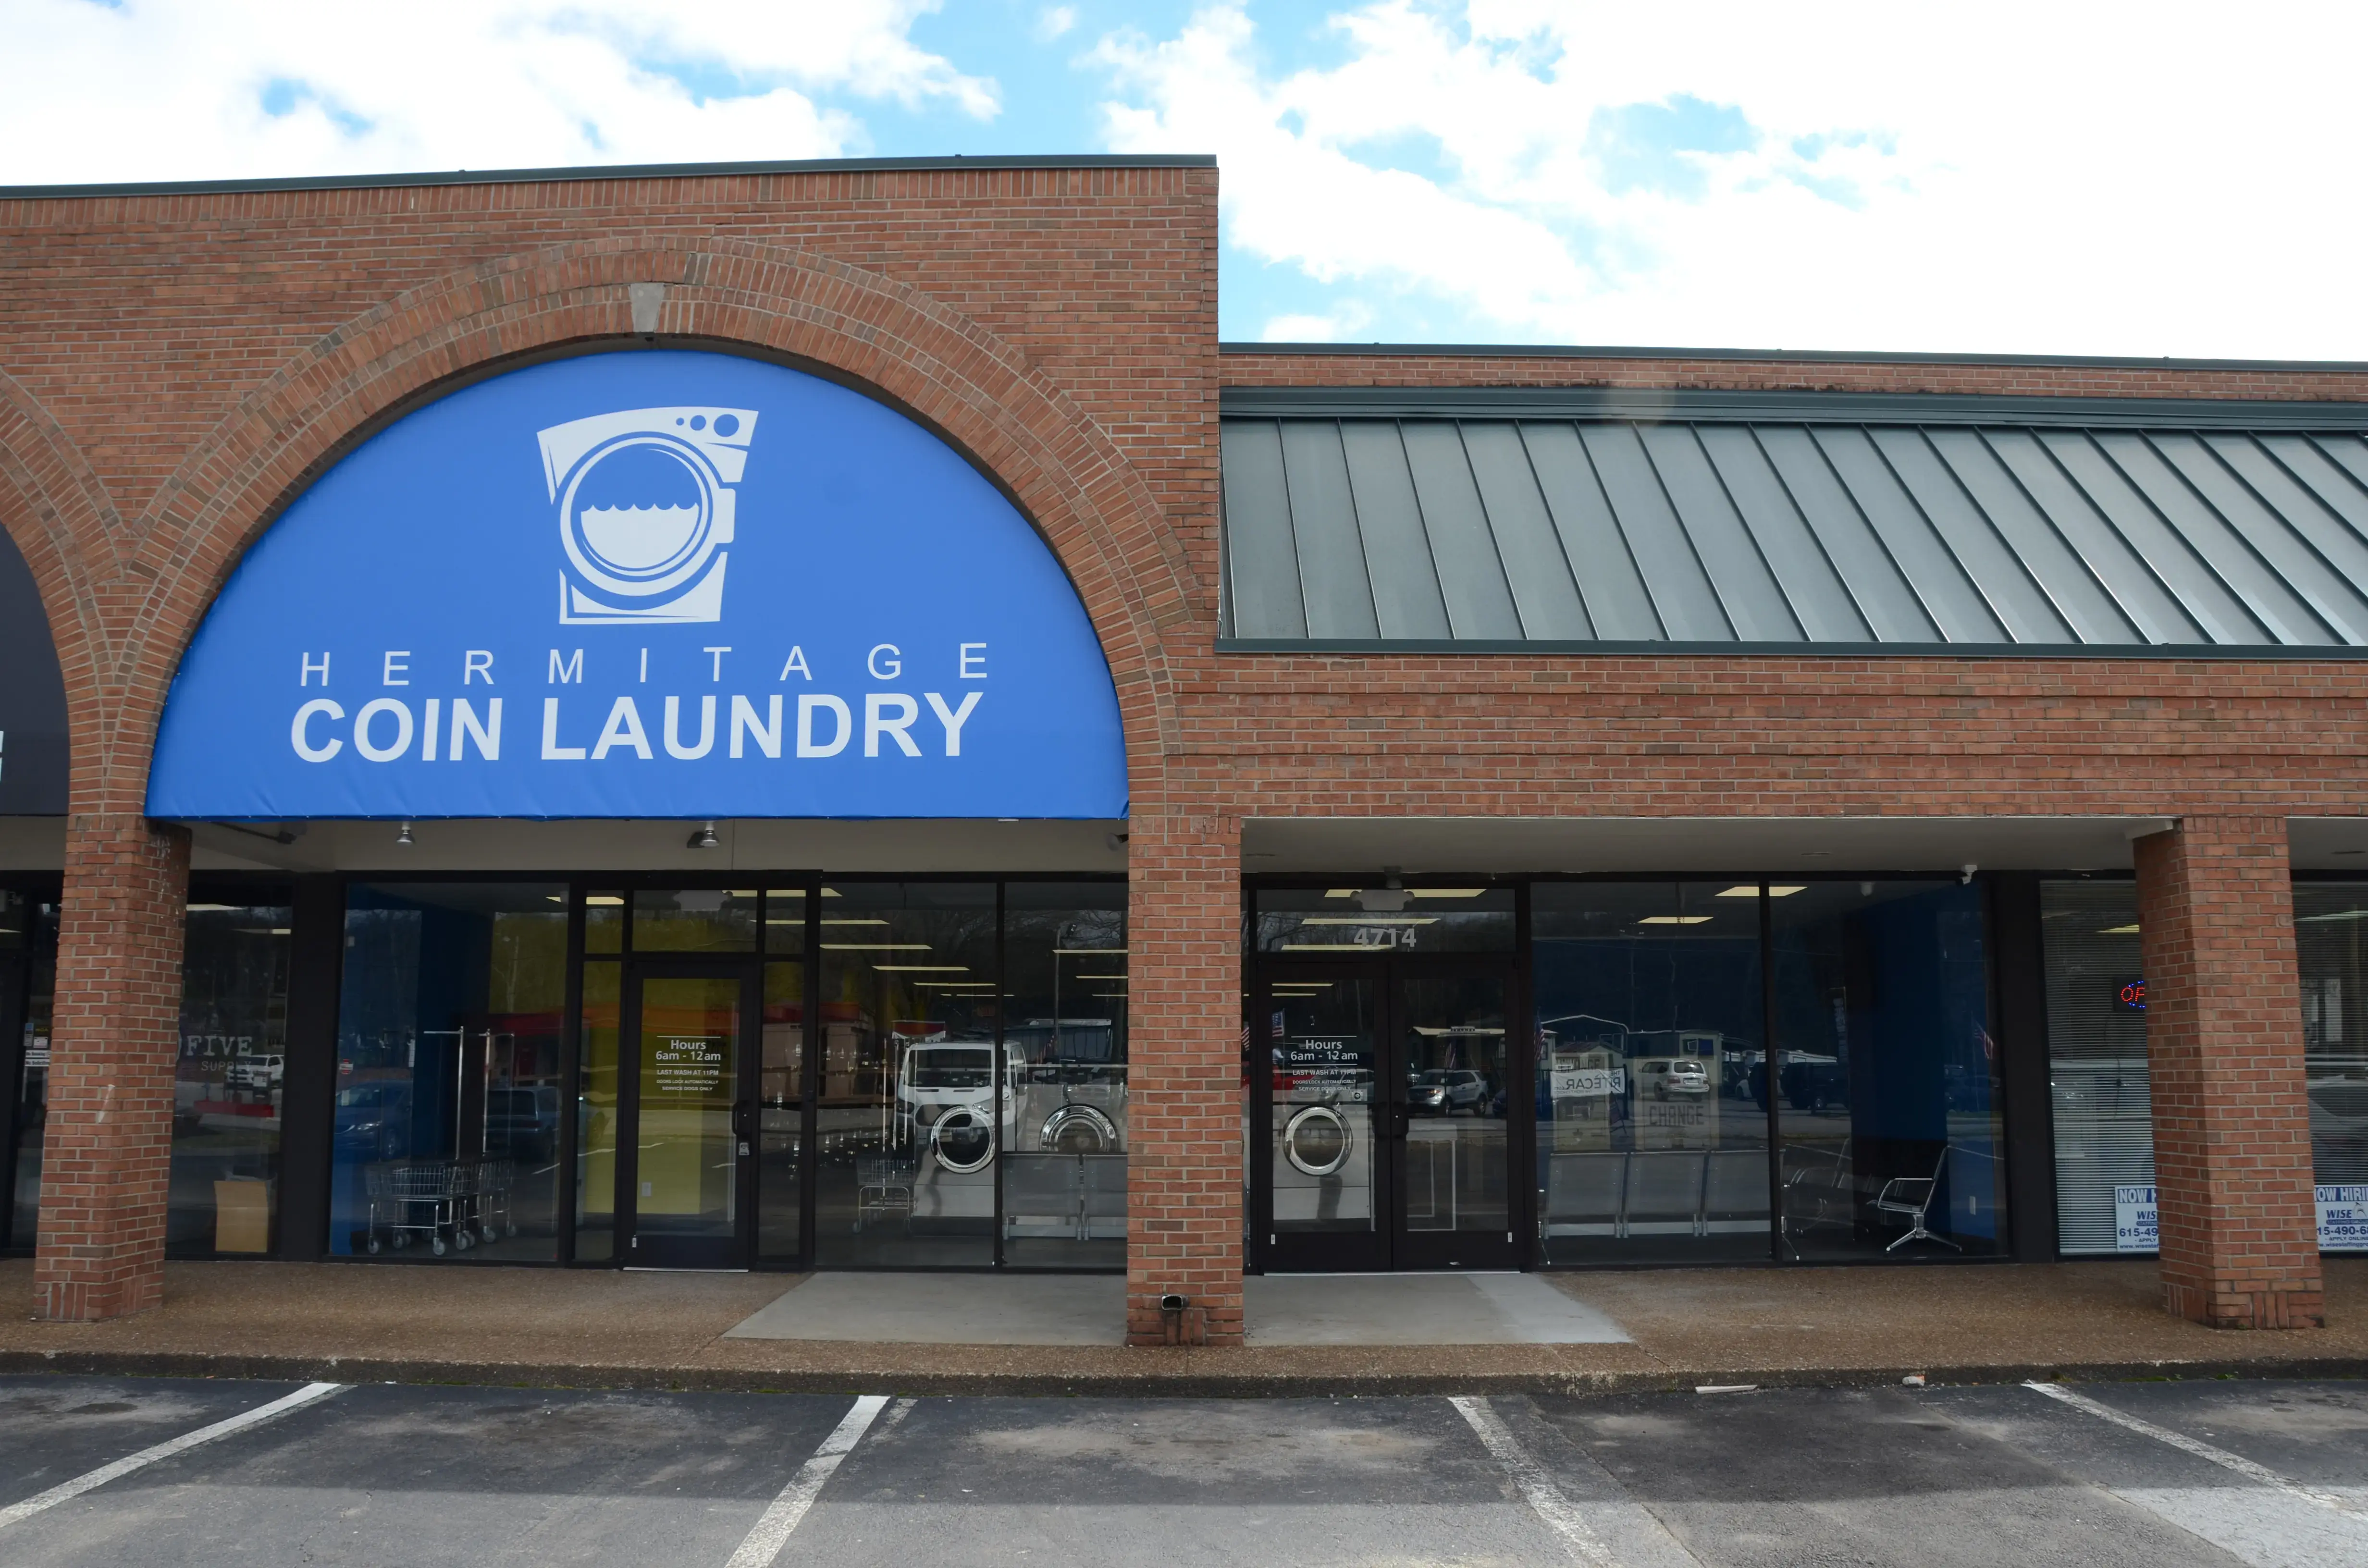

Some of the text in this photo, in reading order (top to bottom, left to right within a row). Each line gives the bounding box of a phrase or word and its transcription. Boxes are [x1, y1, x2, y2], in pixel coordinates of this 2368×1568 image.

[301, 643, 987, 686] HERMITAGE
[292, 692, 983, 762] COIN LAUNDRY
[1354, 928, 1417, 947] 4714
[186, 1035, 252, 1056] FIVE
[671, 1040, 706, 1050] Hours
[1306, 1040, 1342, 1050] Hours
[656, 1051, 679, 1060] 6am
[1291, 1051, 1315, 1060] 6am
[1649, 1106, 1705, 1126] CHANGE
[2119, 1189, 2147, 1202] NOW
[2137, 1211, 2157, 1220] WIS
[2326, 1210, 2352, 1218] WISE
